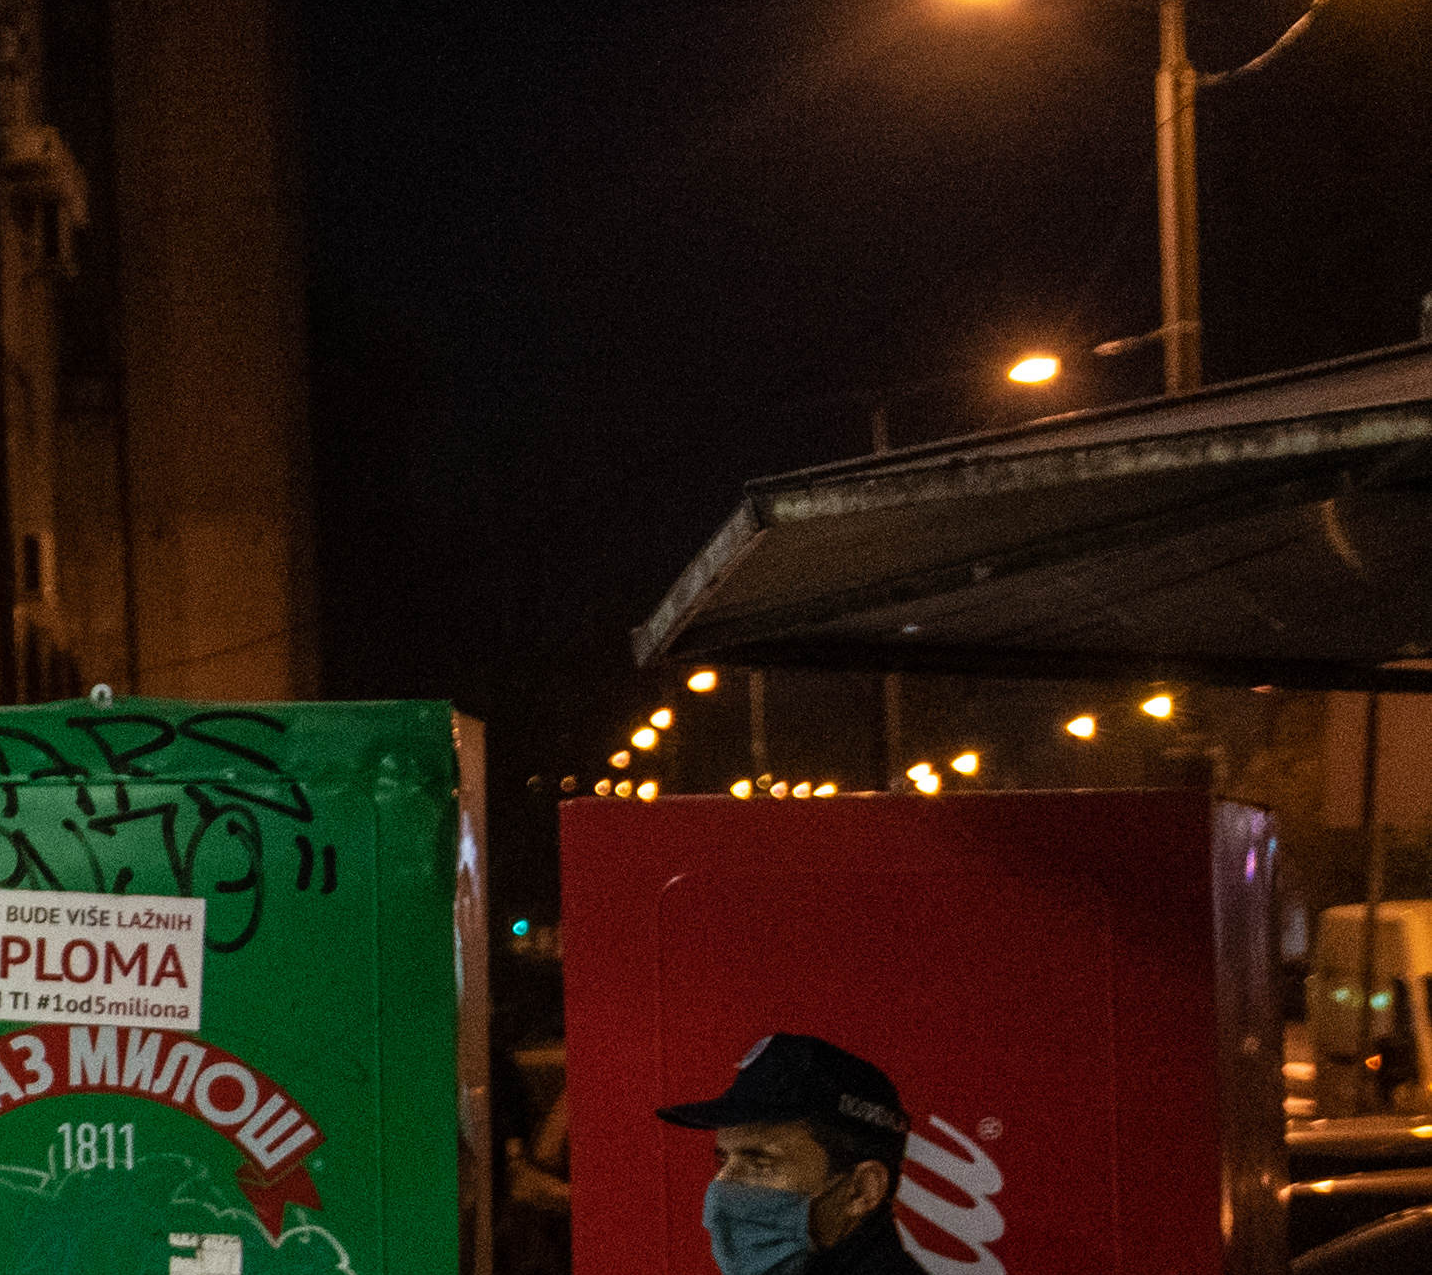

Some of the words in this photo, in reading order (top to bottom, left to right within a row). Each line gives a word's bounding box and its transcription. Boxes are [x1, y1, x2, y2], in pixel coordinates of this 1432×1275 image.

[5, 905, 61, 925] BUDE
[66, 905, 112, 927] VIŠE
[116, 908, 193, 931] LAŽNIH
[8, 991, 30, 1010] TI
[36, 993, 190, 1020] #1od5miliona
[68, 1025, 317, 1171] МИЛОШ
[56, 1122, 135, 1170] 1811
